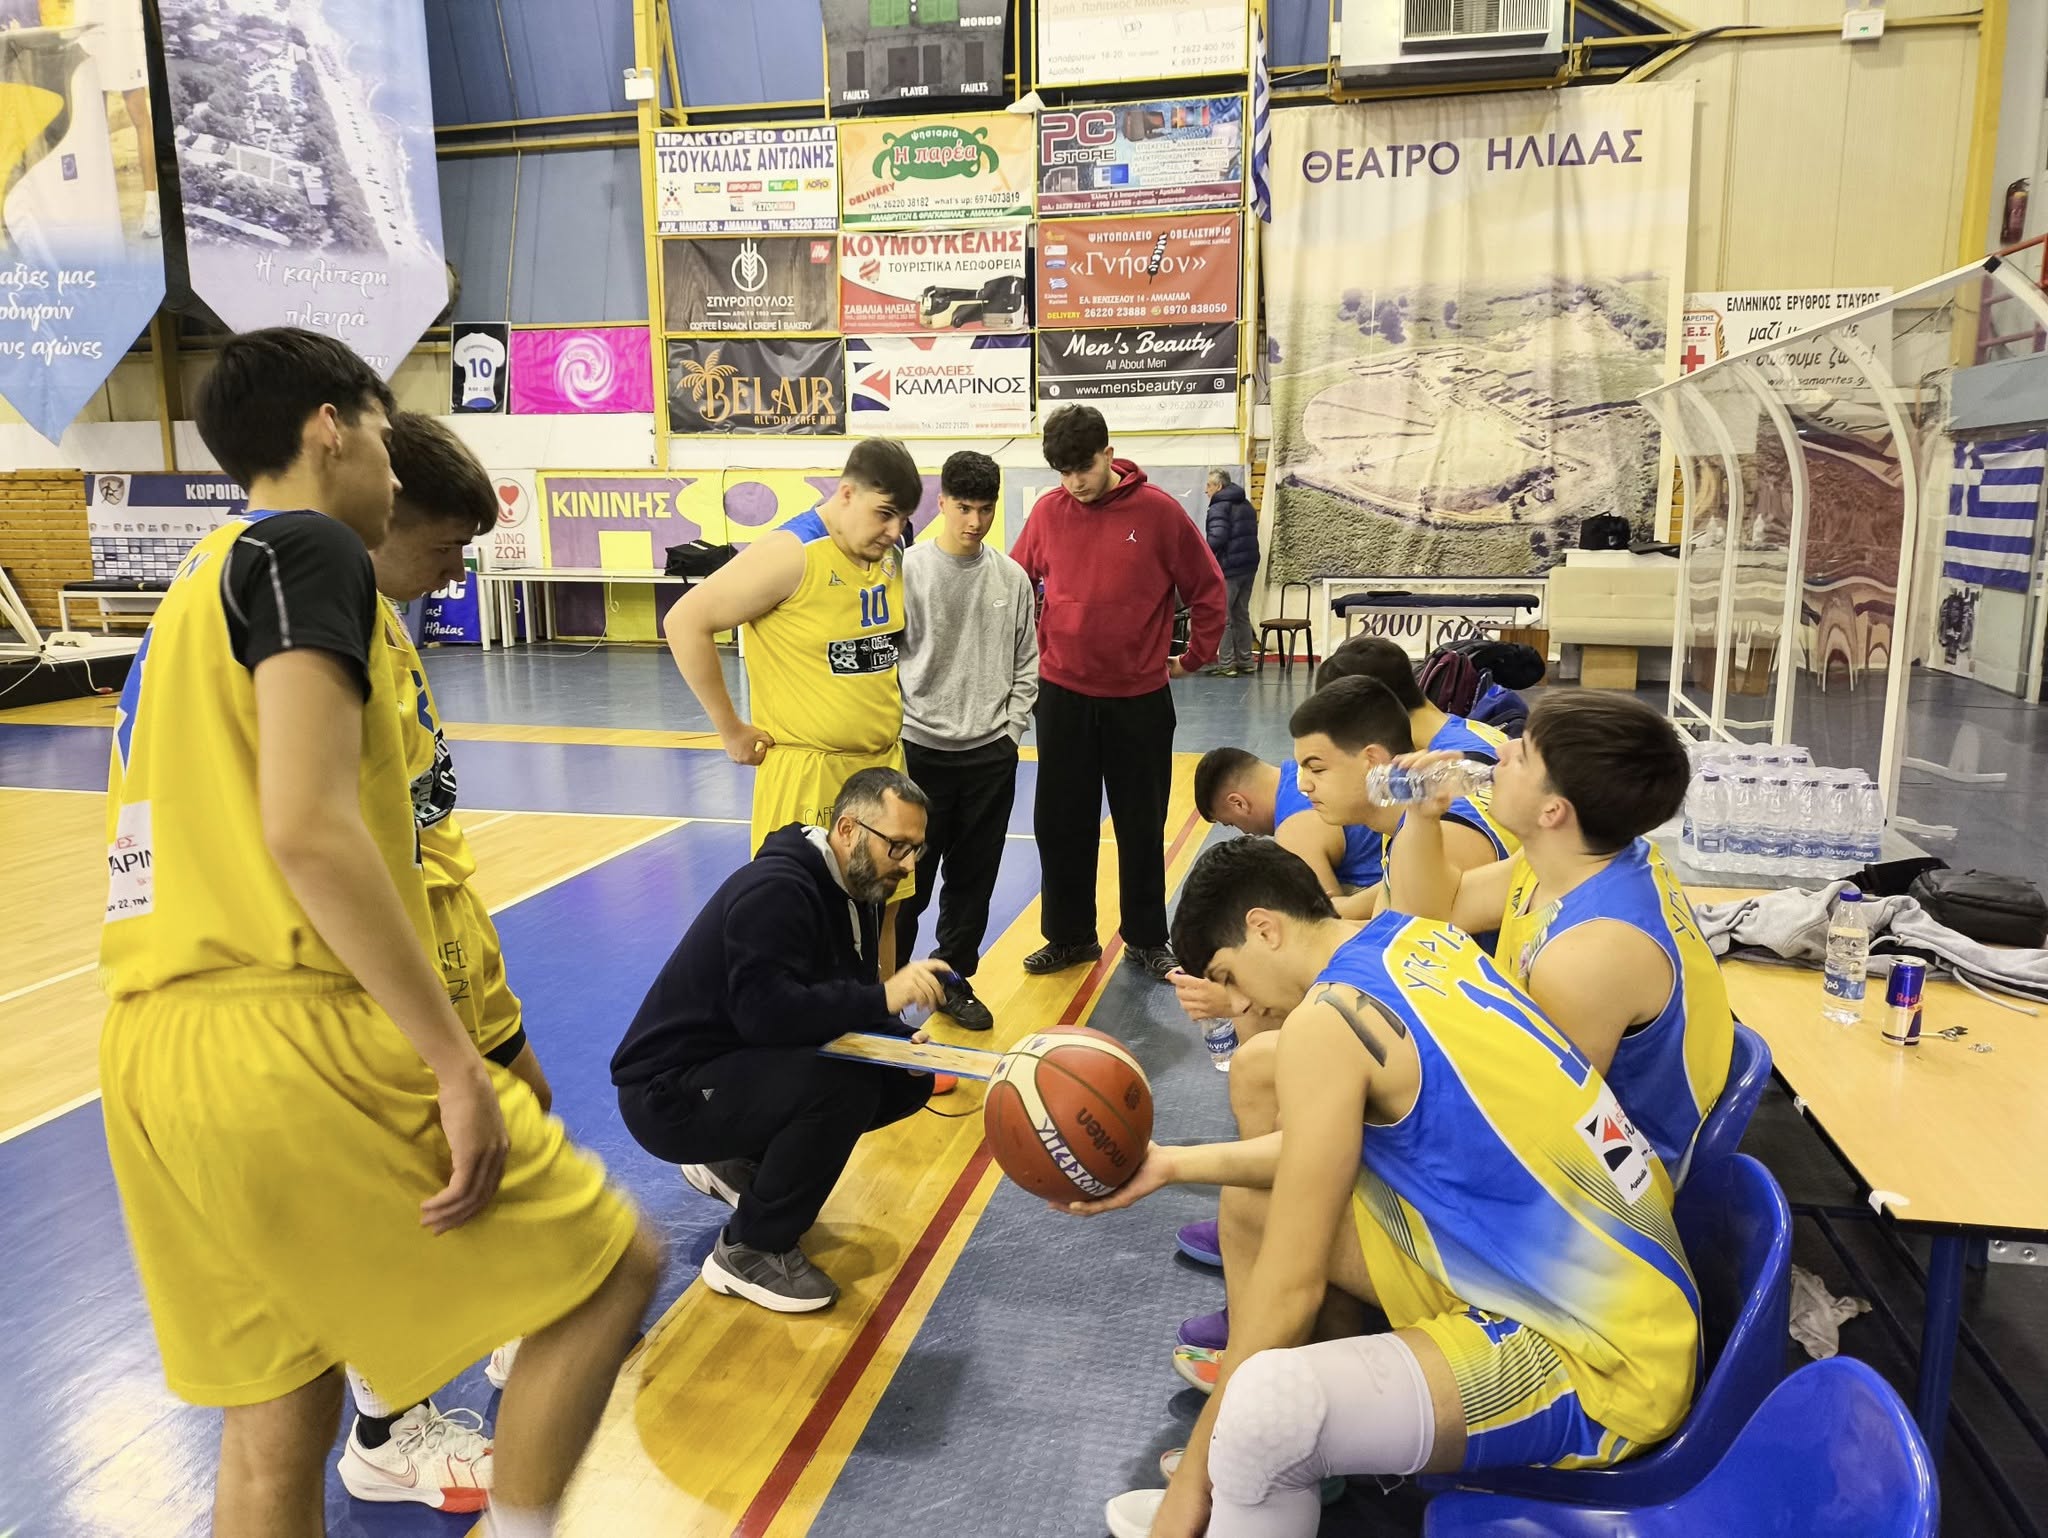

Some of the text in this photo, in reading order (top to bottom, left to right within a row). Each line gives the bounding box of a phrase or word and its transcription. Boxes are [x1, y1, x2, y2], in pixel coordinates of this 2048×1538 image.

[960, 16, 1002, 27] MONDO
[843, 90, 869, 101] FAULTS
[901, 85, 929, 97] PLAYER
[961, 82, 988, 93] FAULTS
[657, 126, 836, 147] ΠΡΑΚΤΟΡΕΙΟ ΟΠΑΠ
[1041, 109, 1116, 166] PC
[659, 144, 834, 173] ΤΣΟΥΚΑΛΑΣ ΑΝΤΩΝΗΣ
[894, 139, 978, 167] Η παρέα
[1053, 149, 1116, 164] STORE
[1302, 129, 1643, 183] ΘΕΑΤΡΟ ΗΛΙΔΑΣ
[849, 182, 896, 206] DELIVERY
[842, 230, 1023, 257] ΚΟΥΜΟΥΚΕΛΗΣ
[1088, 226, 1231, 243] ΨΗΤΟΠΩΛΕΙΟ ΟΒΕΛΙΣΤΗΡΙΟ
[888, 259, 1022, 273] ΤΟΥΡΙΣΤΙΚΑ ΛΕΩΦΟΡΕΙΑ
[57, 270, 97, 297] μας
[255, 251, 390, 300] Η καλύτερη
[706, 296, 795, 308] ΣΠΥΡΟΠΟΥΛΟΣ
[844, 302, 916, 315] ΣΑΒΑΛΙΑ ΗΛΕΙΑΣ
[1047, 303, 1227, 319] DELIVERY 26220 23888 6970 838050
[1726, 296, 1781, 312] ΕΛΛΗΝΙΚΟΣ
[1787, 294, 1831, 310] ΕΡΥΘΡΟΣ
[286, 301, 369, 340] πλευρά
[690, 320, 812, 331] COFFEE SNACK CREPE BAKERY
[1748, 321, 1783, 344] μαζί
[32, 335, 103, 367] αγώνες
[1062, 331, 1216, 358] Men's Beauty
[468, 357, 492, 378] 10
[896, 365, 975, 377] ΑΣΦΑΛΕΙΕΣ
[1105, 358, 1167, 370] All About Men
[895, 377, 1026, 395] ΚΑΜΑΡΙΝΟΣ
[1076, 379, 1197, 396] www.mensbeauty.gr
[754, 415, 770, 425] ALL
[773, 415, 791, 425] DAY
[551, 491, 673, 519] ΚΙΝΙΝΗΣ
[494, 533, 526, 545] ΔΙΝΩ
[495, 547, 527, 559] ΖΩΗ
[860, 583, 890, 628] 10
[1076, 1106, 1128, 1168] molten
